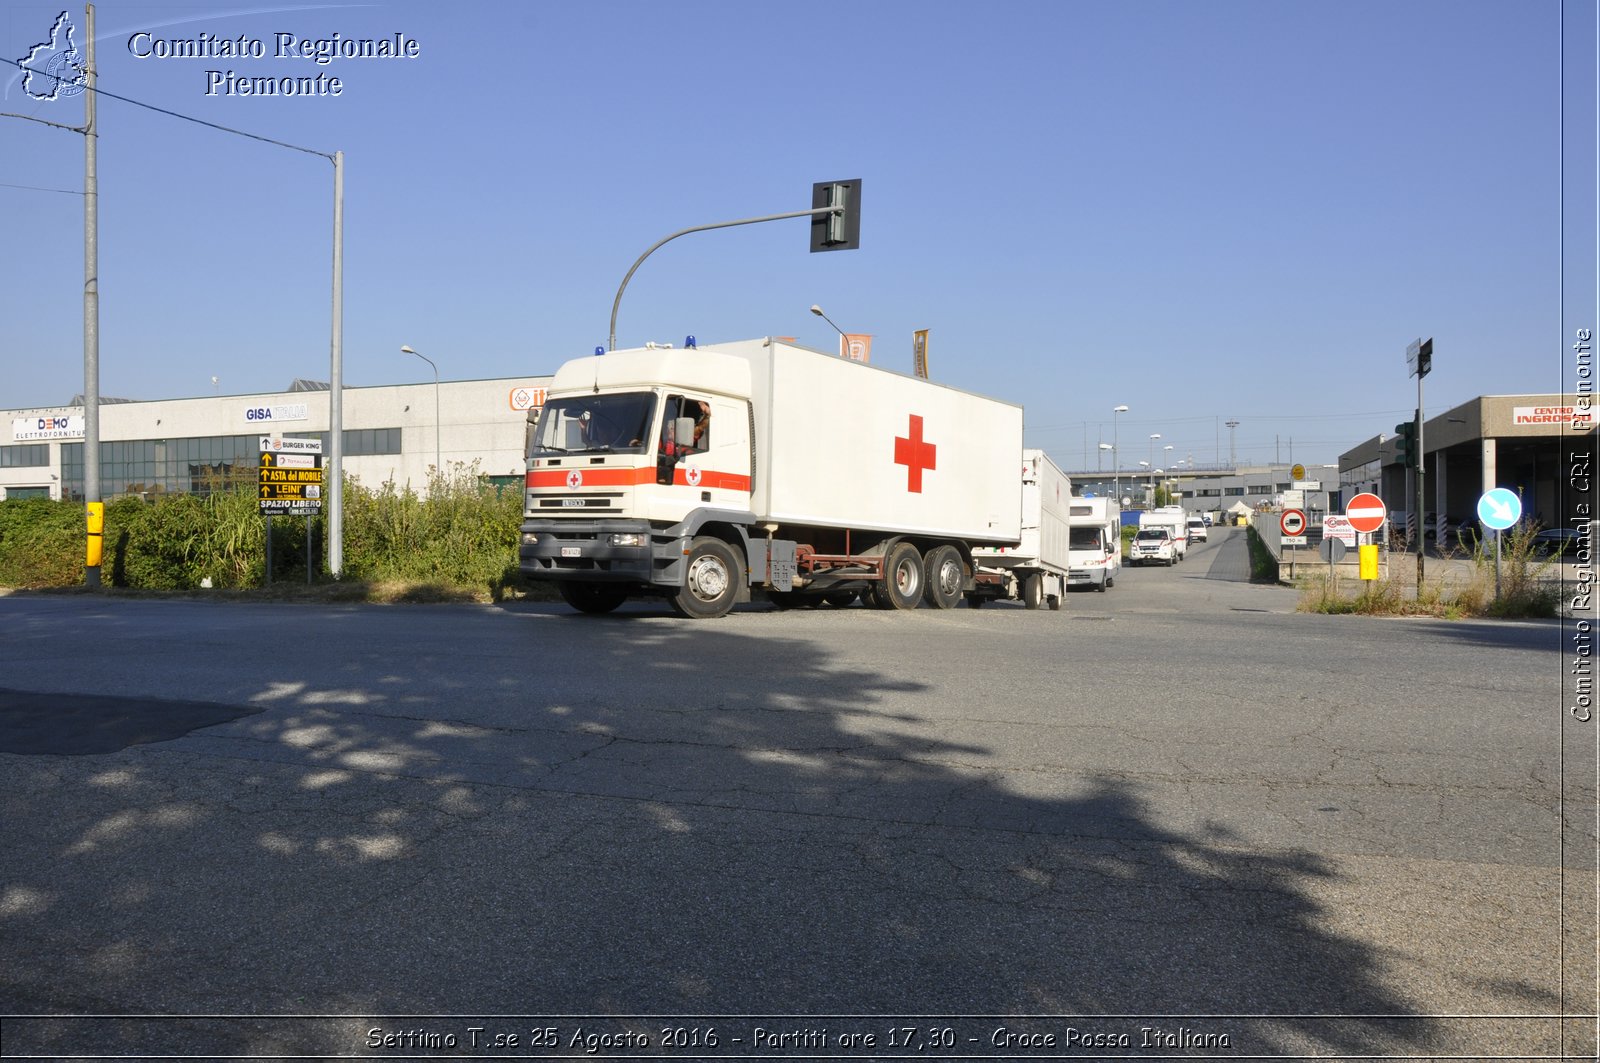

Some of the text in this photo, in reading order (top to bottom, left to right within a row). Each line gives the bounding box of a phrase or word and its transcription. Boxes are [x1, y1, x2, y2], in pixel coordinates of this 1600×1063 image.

[246, 408, 272, 420] GISA
[1534, 407, 1574, 415] CENTRO
[1517, 415, 1592, 423] INGROSSO
[38, 418, 68, 430] DEMO
[270, 471, 322, 481] ASTA del MOBILE
[260, 500, 322, 508] SPAZIO LIBERO
